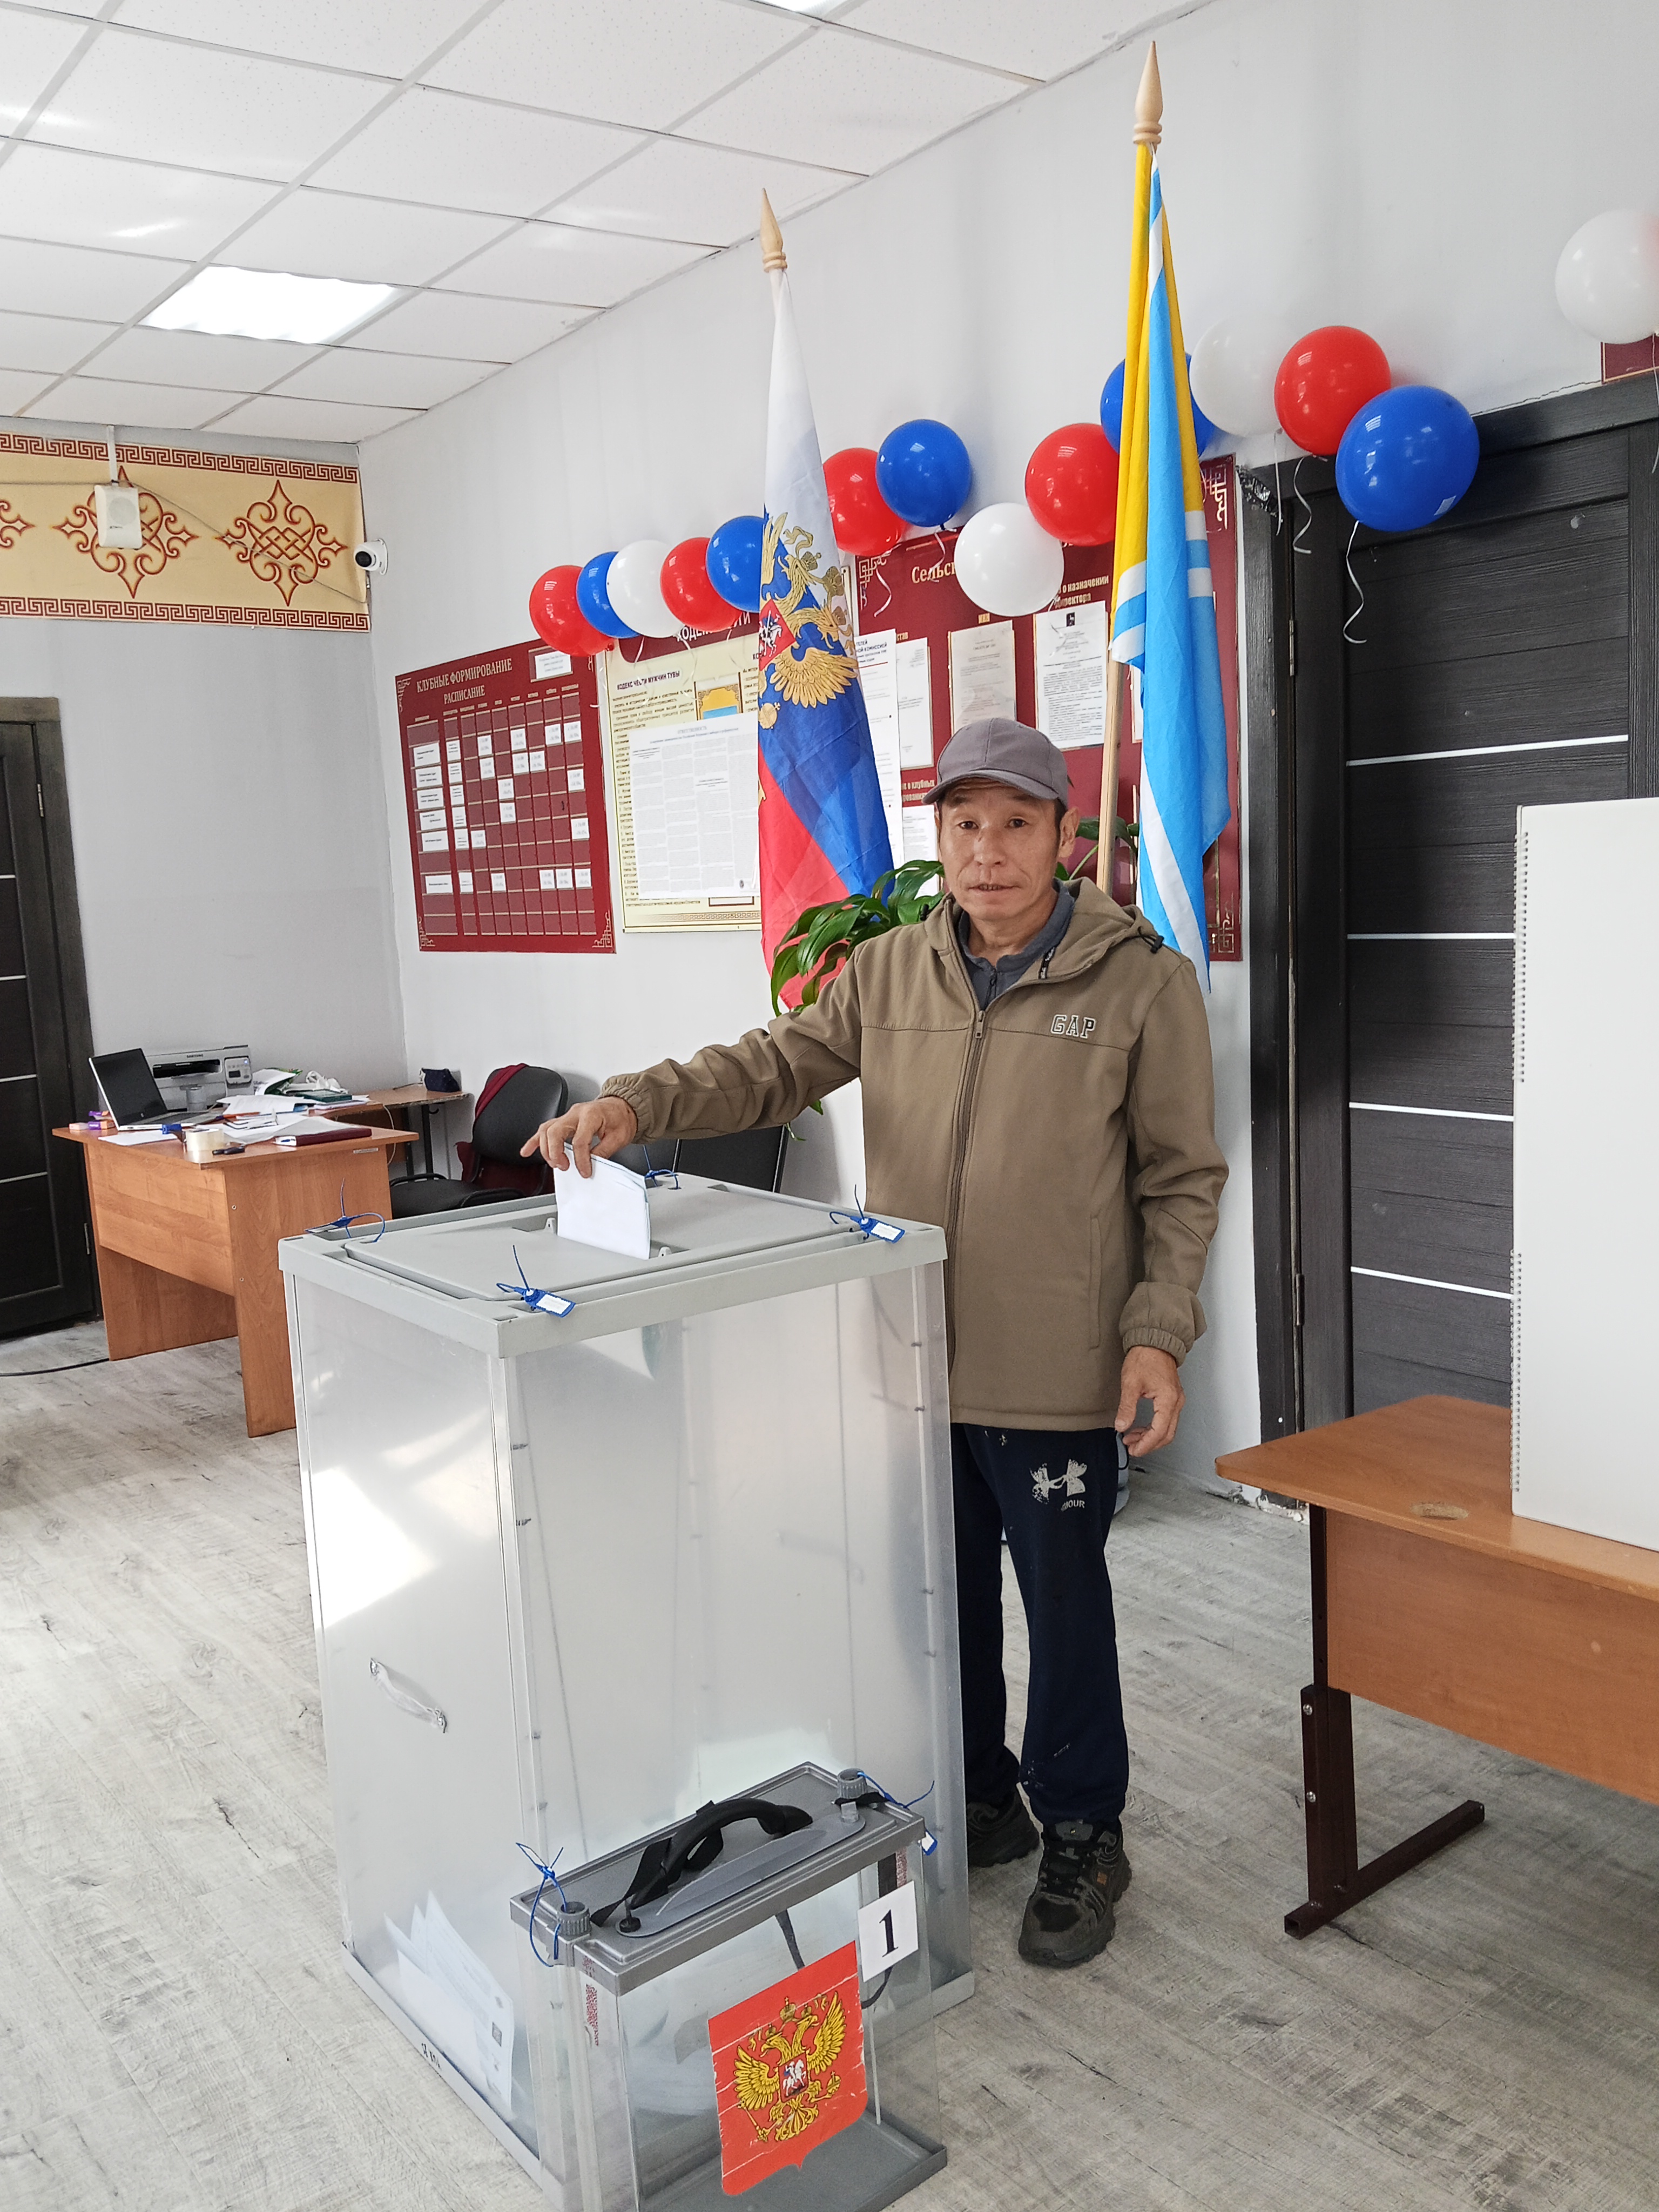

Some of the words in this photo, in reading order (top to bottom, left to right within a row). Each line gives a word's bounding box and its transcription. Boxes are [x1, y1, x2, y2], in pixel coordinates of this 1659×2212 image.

[1068, 575, 1109, 592] назначении
[417, 673, 450, 693] КЛУБНЫЕ
[450, 658, 512, 685] ФОРМИРОВАНИЕ
[443, 685, 485, 704] РАСПИСАНИЕ
[1050, 1014, 1096, 1038] GAP
[879, 1909, 899, 1958] 1
